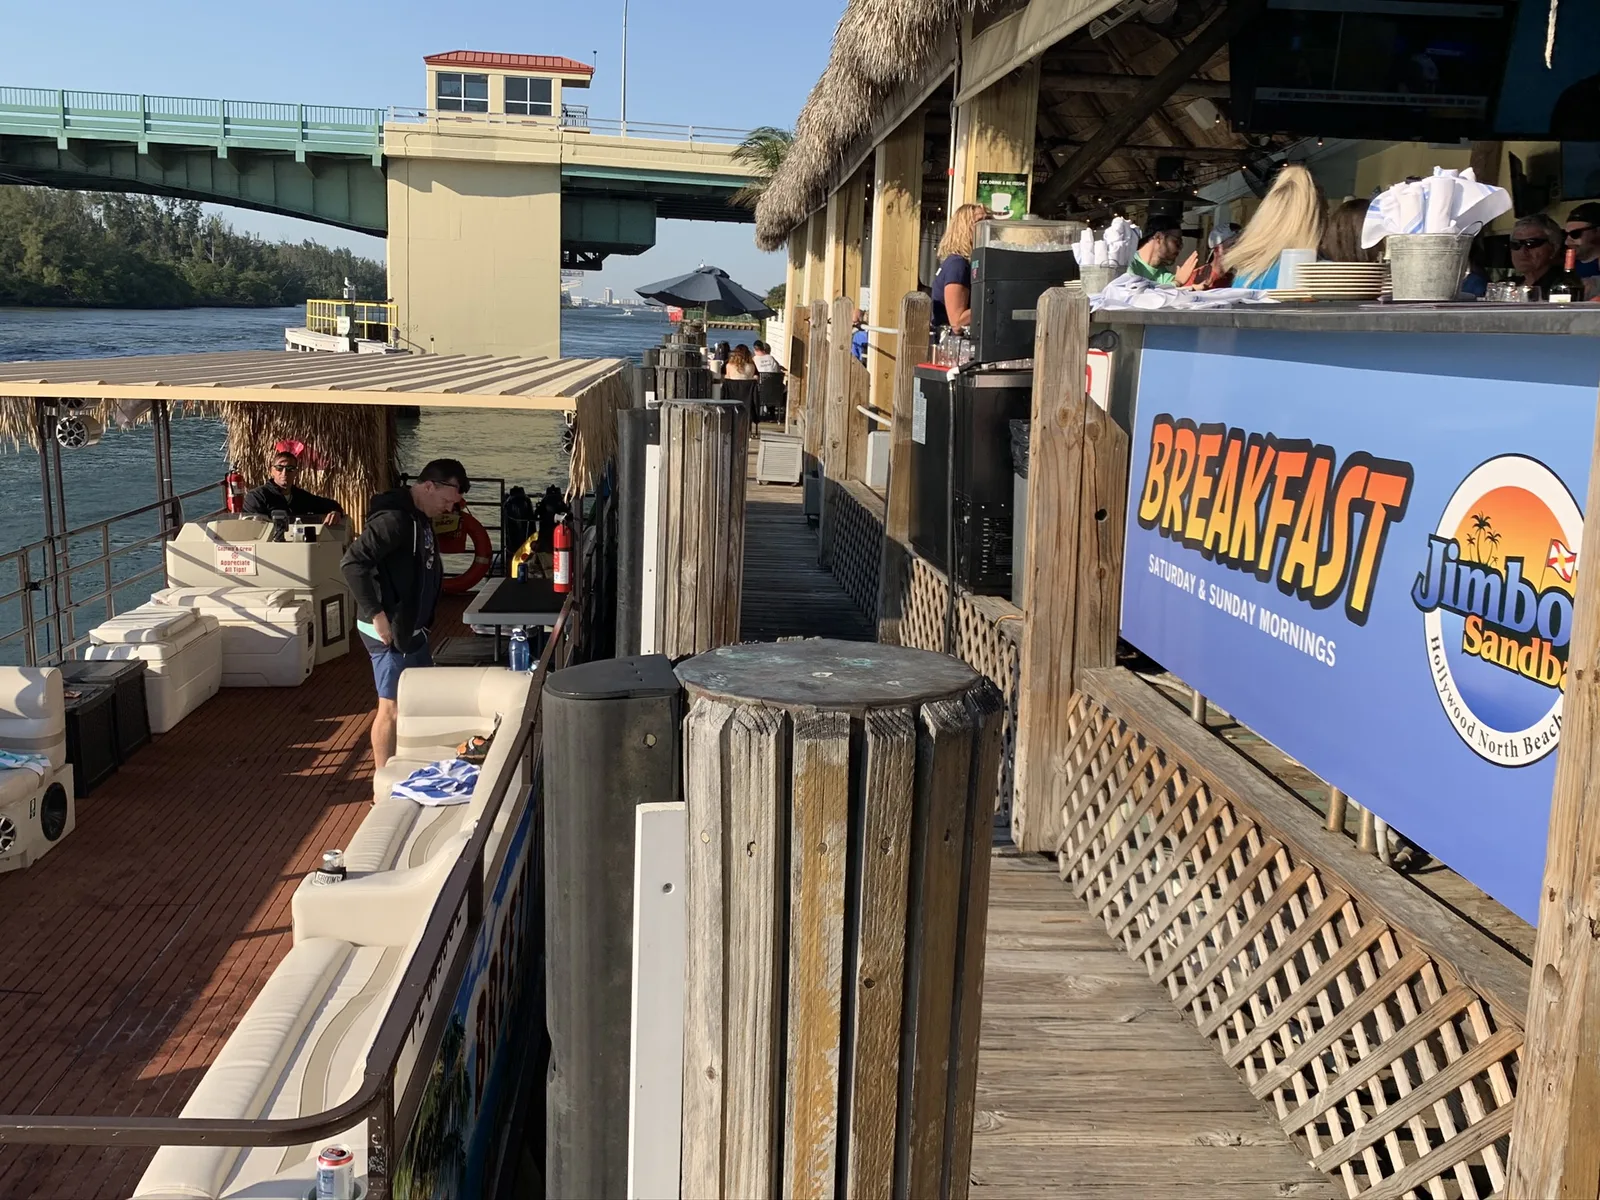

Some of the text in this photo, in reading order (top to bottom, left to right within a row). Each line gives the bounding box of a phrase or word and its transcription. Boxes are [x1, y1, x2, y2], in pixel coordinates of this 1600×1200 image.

[1138, 413, 1413, 625] BREAKFAST
[1148, 553, 1337, 667] SATURDAY & SUNDAY MORNINGS
[1430, 635, 1563, 758] Hollywood North Beach
